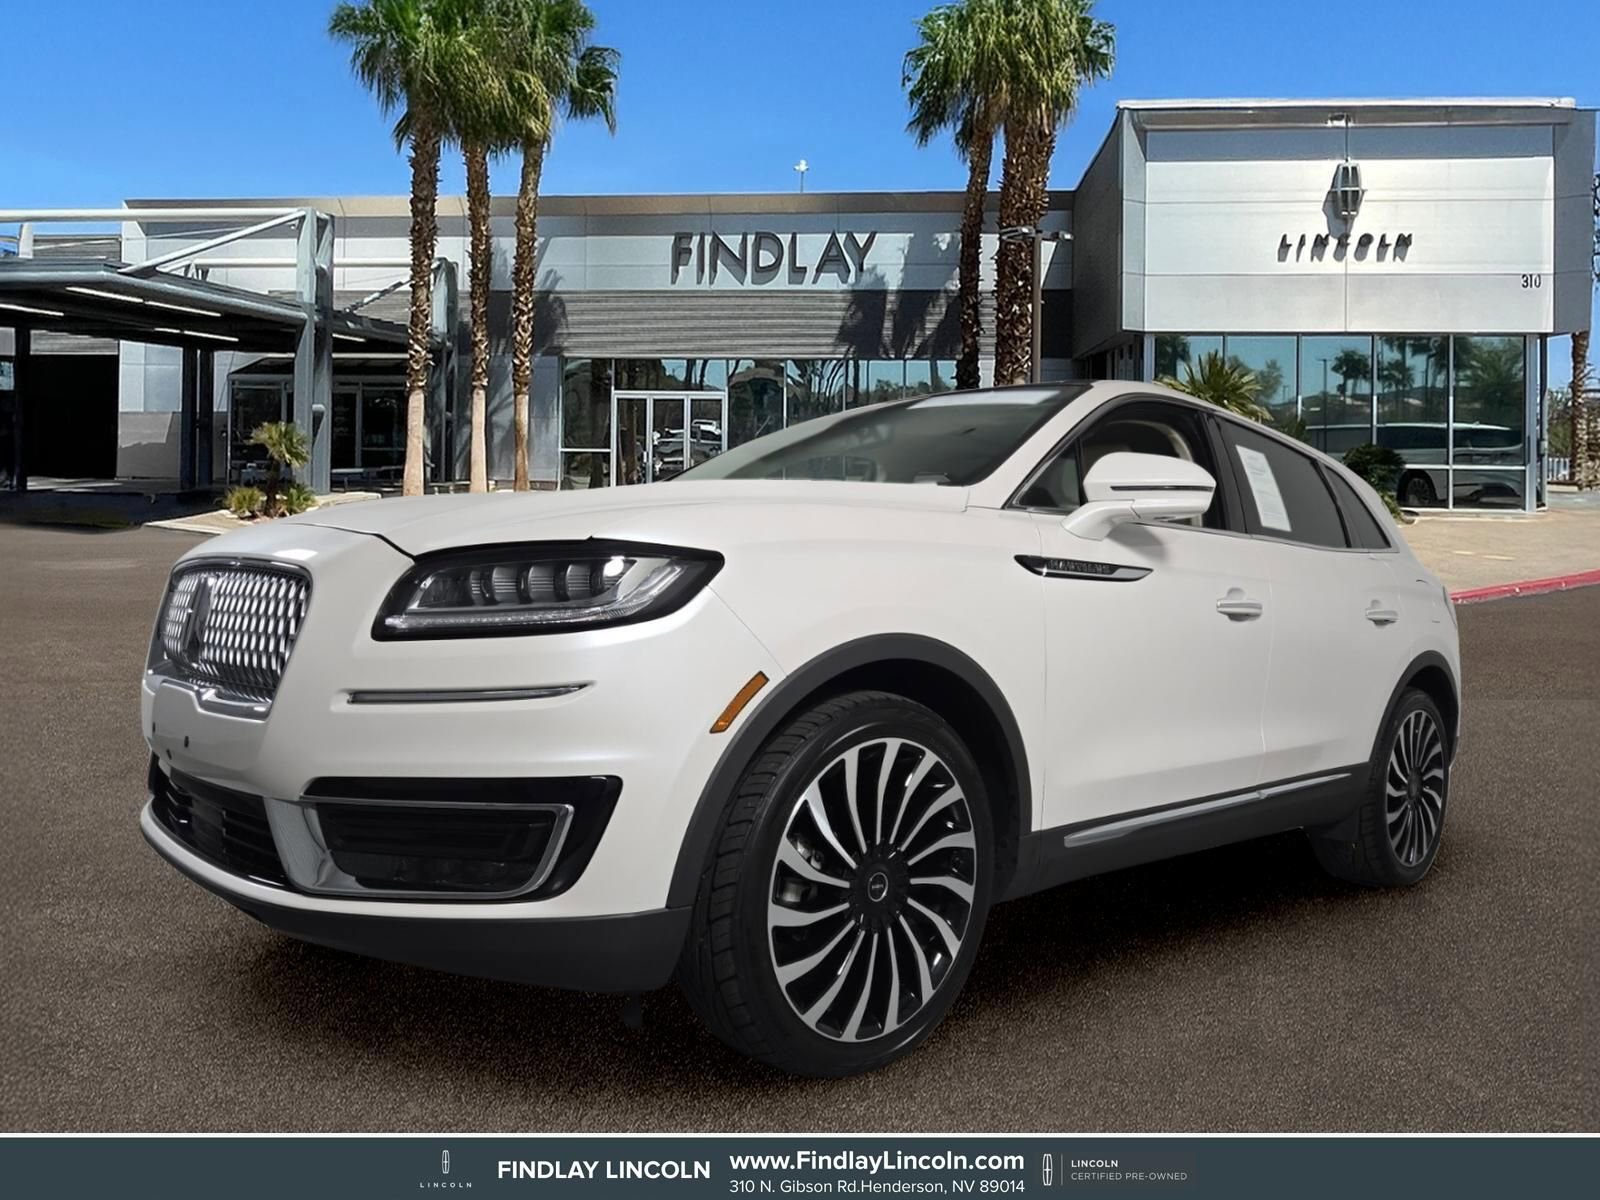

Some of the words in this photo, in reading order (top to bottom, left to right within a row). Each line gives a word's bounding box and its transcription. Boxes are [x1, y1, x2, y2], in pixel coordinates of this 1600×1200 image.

[671, 230, 878, 283] FINDLAY
[1277, 232, 1413, 262] LINCOLN
[1521, 273, 1542, 289] 310
